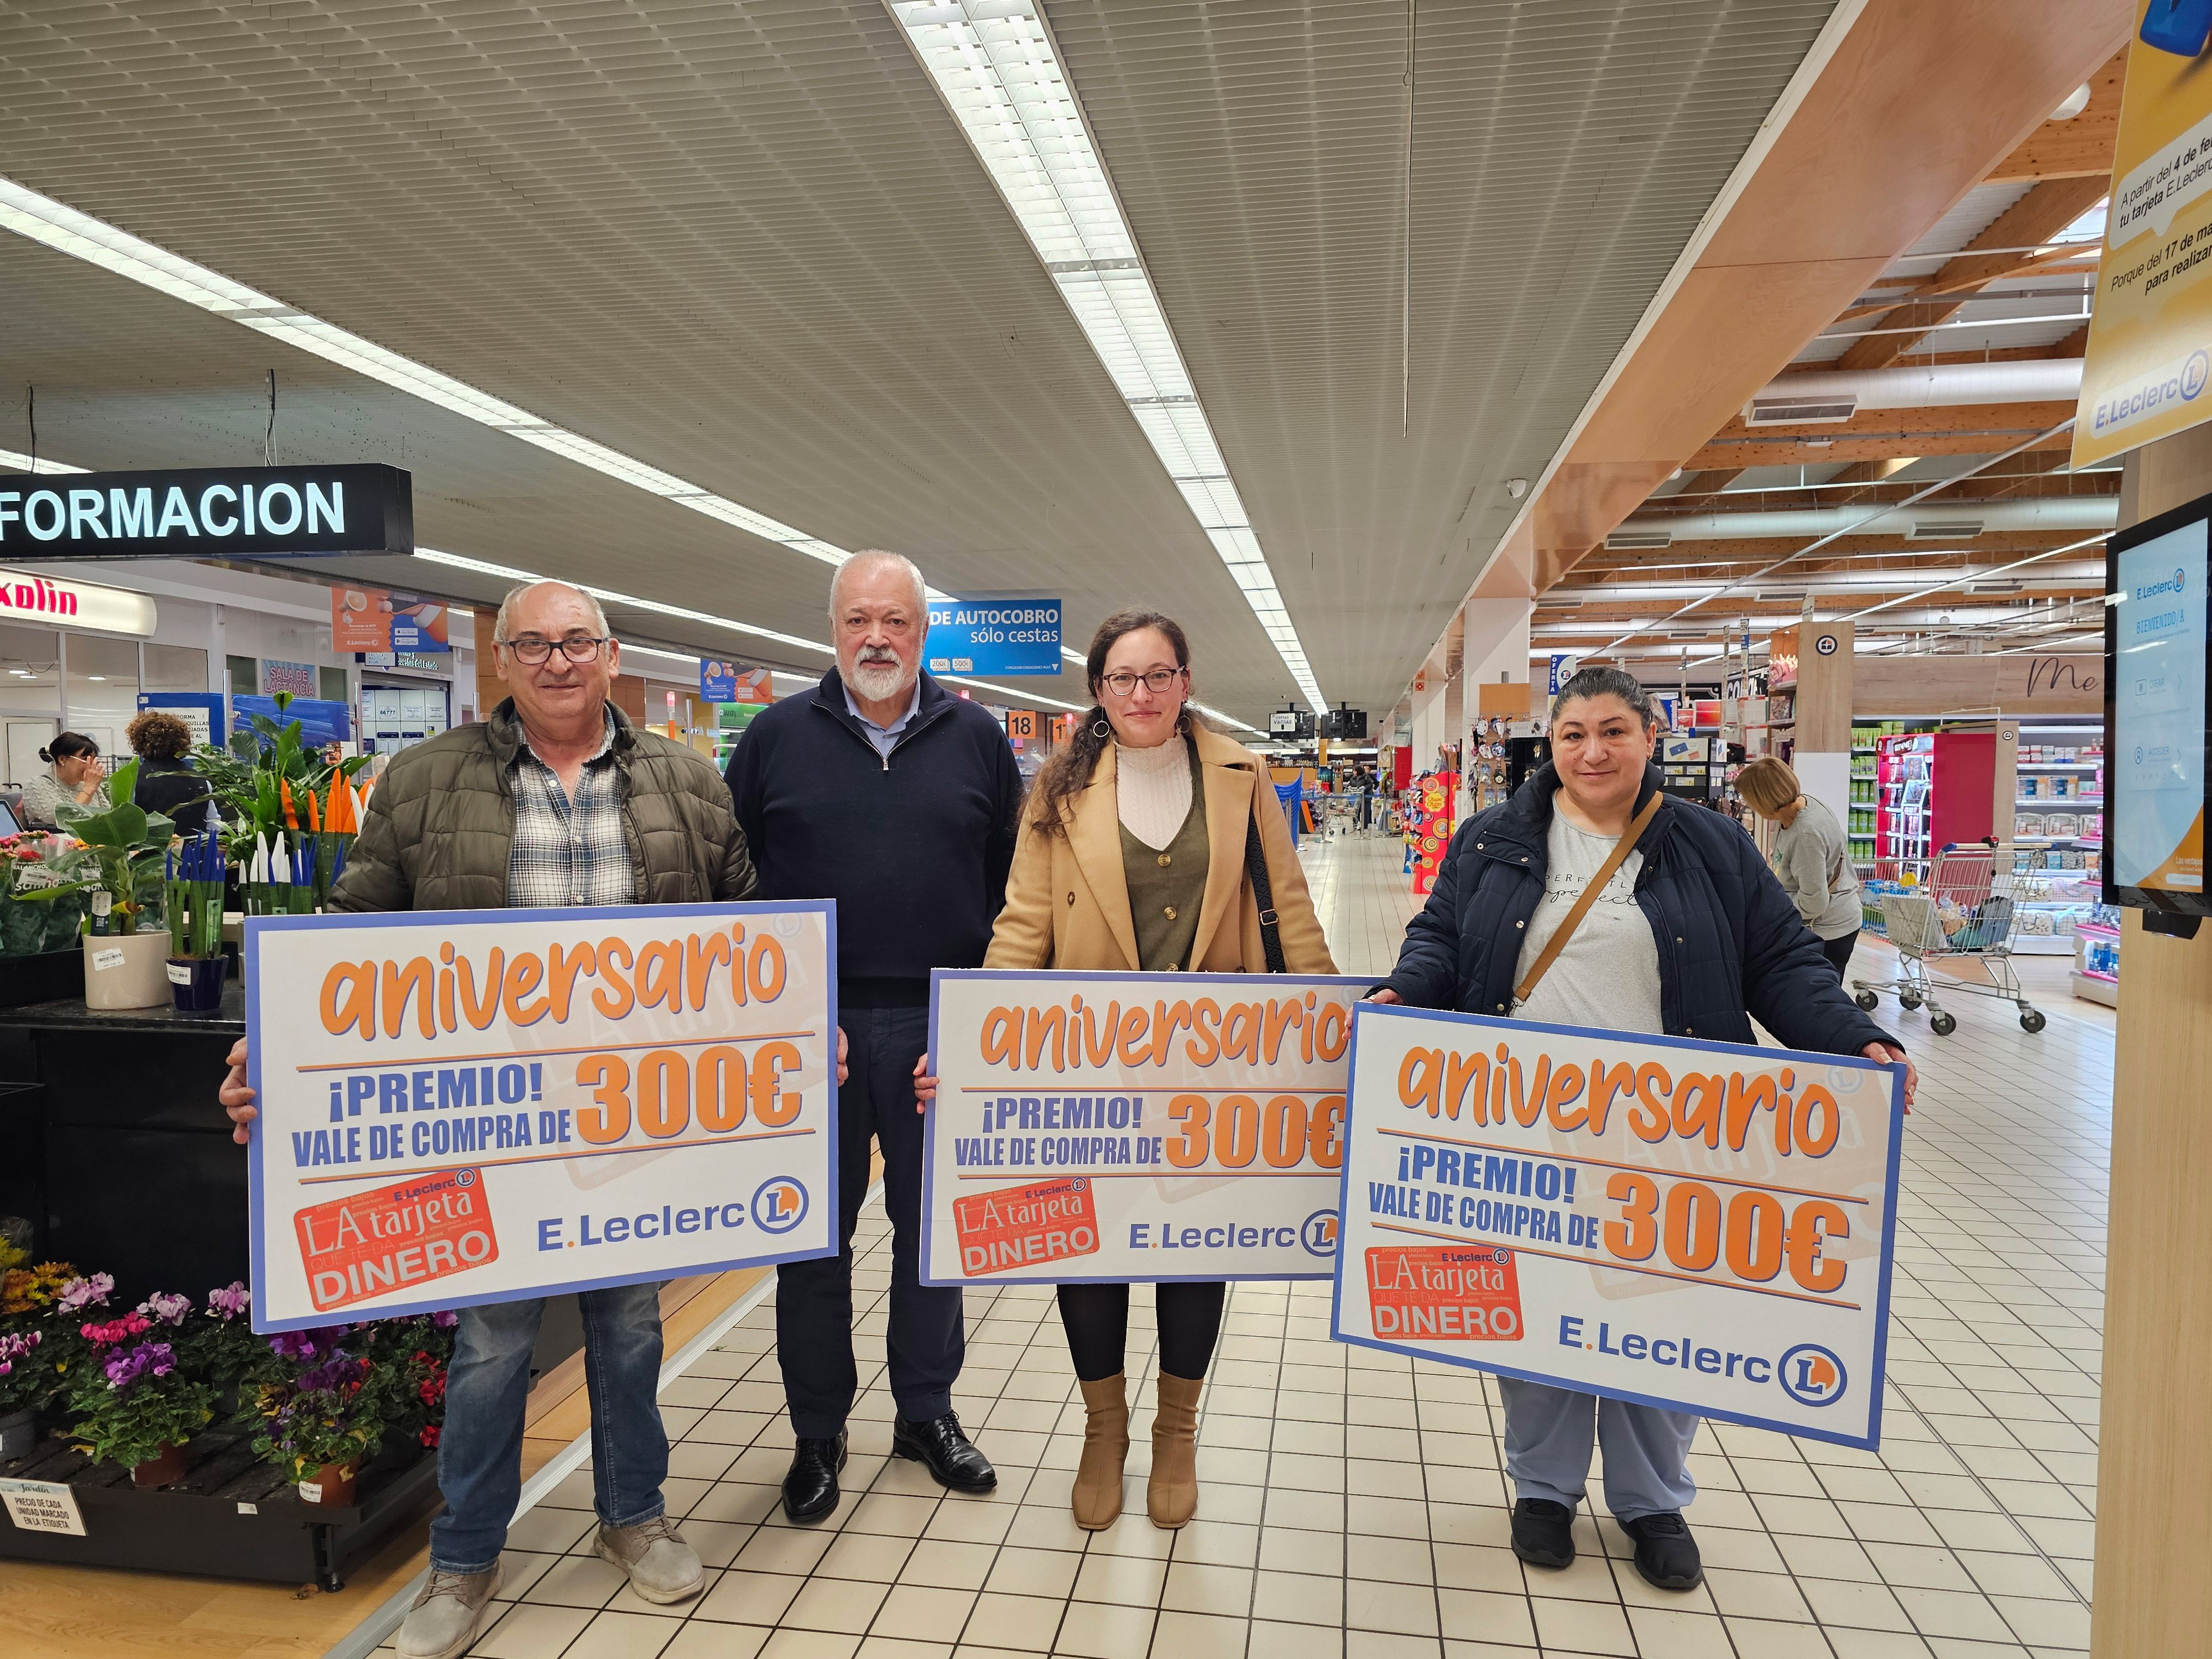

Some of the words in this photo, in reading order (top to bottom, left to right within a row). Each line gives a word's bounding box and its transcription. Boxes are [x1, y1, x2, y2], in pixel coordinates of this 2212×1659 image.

[2121, 192, 2128, 209] A
[2130, 176, 2154, 206] partir
[2157, 160, 2172, 184] del
[2174, 155, 2180, 171] 4
[2183, 148, 2197, 166] de
[2120, 213, 2130, 228] tu
[2132, 191, 2163, 220] tarjeta
[2111, 264, 2144, 292] Porque
[2147, 249, 2162, 271] del
[2165, 239, 2178, 260] 17
[2180, 234, 2193, 251] de
[2145, 270, 2169, 296] para
[2172, 245, 2212, 277] realizar
[2096, 378, 2178, 429] E.Leclerc
[2137, 580, 2172, 600] E.Leclerc
[930, 611, 951, 625] DE
[955, 609, 1058, 624] AUTOCOBRO
[2137, 609, 2184, 634] BIENVENIDO/A
[971, 627, 1004, 643] sólo
[1009, 628, 1058, 642] cestas
[264, 679, 315, 696] LACTANCIA
[270, 666, 294, 681] SALA
[296, 669, 308, 683] DE
[1012, 717, 1031, 735] 18
[320, 922, 786, 1041] aniversario
[980, 991, 1348, 1073] aniversario
[330, 1063, 542, 1123] ¡PREMIO!
[576, 1041, 802, 1145] 300€
[1398, 1042, 1840, 1159] aniversario
[982, 1097, 1143, 1134] ¡PREMIO!
[291, 1126, 361, 1168] VALE
[370, 1123, 404, 1160] DE
[412, 1112, 532, 1156] COMPRA
[539, 1108, 571, 1145] DE
[1166, 1094, 1346, 1170] 300€
[955, 1138, 1004, 1166] VALE
[1009, 1138, 1035, 1166] DE
[1041, 1136, 1132, 1165] COMPRA
[1136, 1136, 1161, 1164] DE
[1398, 1145, 1576, 1203] ¡PREMIO!
[316, 1198, 348, 1212] precios
[351, 1192, 374, 1203] bajos
[394, 1178, 456, 1202] E.Leclerc
[969, 1192, 993, 1201] precios
[1026, 1185, 1071, 1198] E.Leclerc
[300, 1206, 368, 1257] LA
[369, 1192, 473, 1238] tarjeta
[352, 1207, 378, 1219] precios
[379, 1202, 397, 1211] bajos
[958, 1198, 1004, 1234] LA
[1006, 1195, 1083, 1226] tarjeta
[1368, 1182, 1420, 1219] VALE
[1426, 1192, 1453, 1224] DE
[1459, 1197, 1562, 1243] COMPRA
[1567, 1215, 1598, 1249] DE
[538, 1201, 745, 1252] E.Leclerc
[963, 1232, 987, 1245] QUE
[990, 1229, 1004, 1240] TE
[1008, 1226, 1025, 1237] DA
[1129, 1223, 1295, 1249] E.Leclerc
[1604, 1172, 1850, 1292] 300€
[311, 1251, 343, 1271] QUE
[347, 1245, 366, 1261] TE
[372, 1239, 395, 1254] DA
[399, 1235, 424, 1248] precios
[425, 1232, 444, 1240] bajos
[964, 1226, 1094, 1271] DINERO
[1052, 1252, 1076, 1261] precios
[1077, 1248, 1094, 1256] bajos
[1442, 1253, 1493, 1261] E.Leclerc
[313, 1230, 491, 1305] DINERO
[436, 1263, 467, 1279] precios
[468, 1257, 492, 1268] bajos
[971, 1267, 990, 1276] precios
[1370, 1254, 1418, 1290] LA
[1421, 1261, 1505, 1297] tarjeta
[326, 1297, 352, 1310] precios
[352, 1292, 372, 1301] bajos
[1374, 1291, 1400, 1303] QUE
[1402, 1291, 1416, 1303] TE
[1421, 1291, 1439, 1303] DA
[1375, 1306, 1517, 1335] DINERO
[1559, 1314, 1771, 1384] E.Leclerc
[14, 1497, 36, 1506] PRECIO
[36, 1499, 46, 1507] DE
[46, 1499, 62, 1509] CADA
[16, 1506, 39, 1516] UNIDAD
[40, 1509, 70, 1520] MARCADO
[23, 1516, 32, 1525] EN
[32, 1517, 41, 1526] LA
[42, 1519, 70, 1529] ETIQUETA
